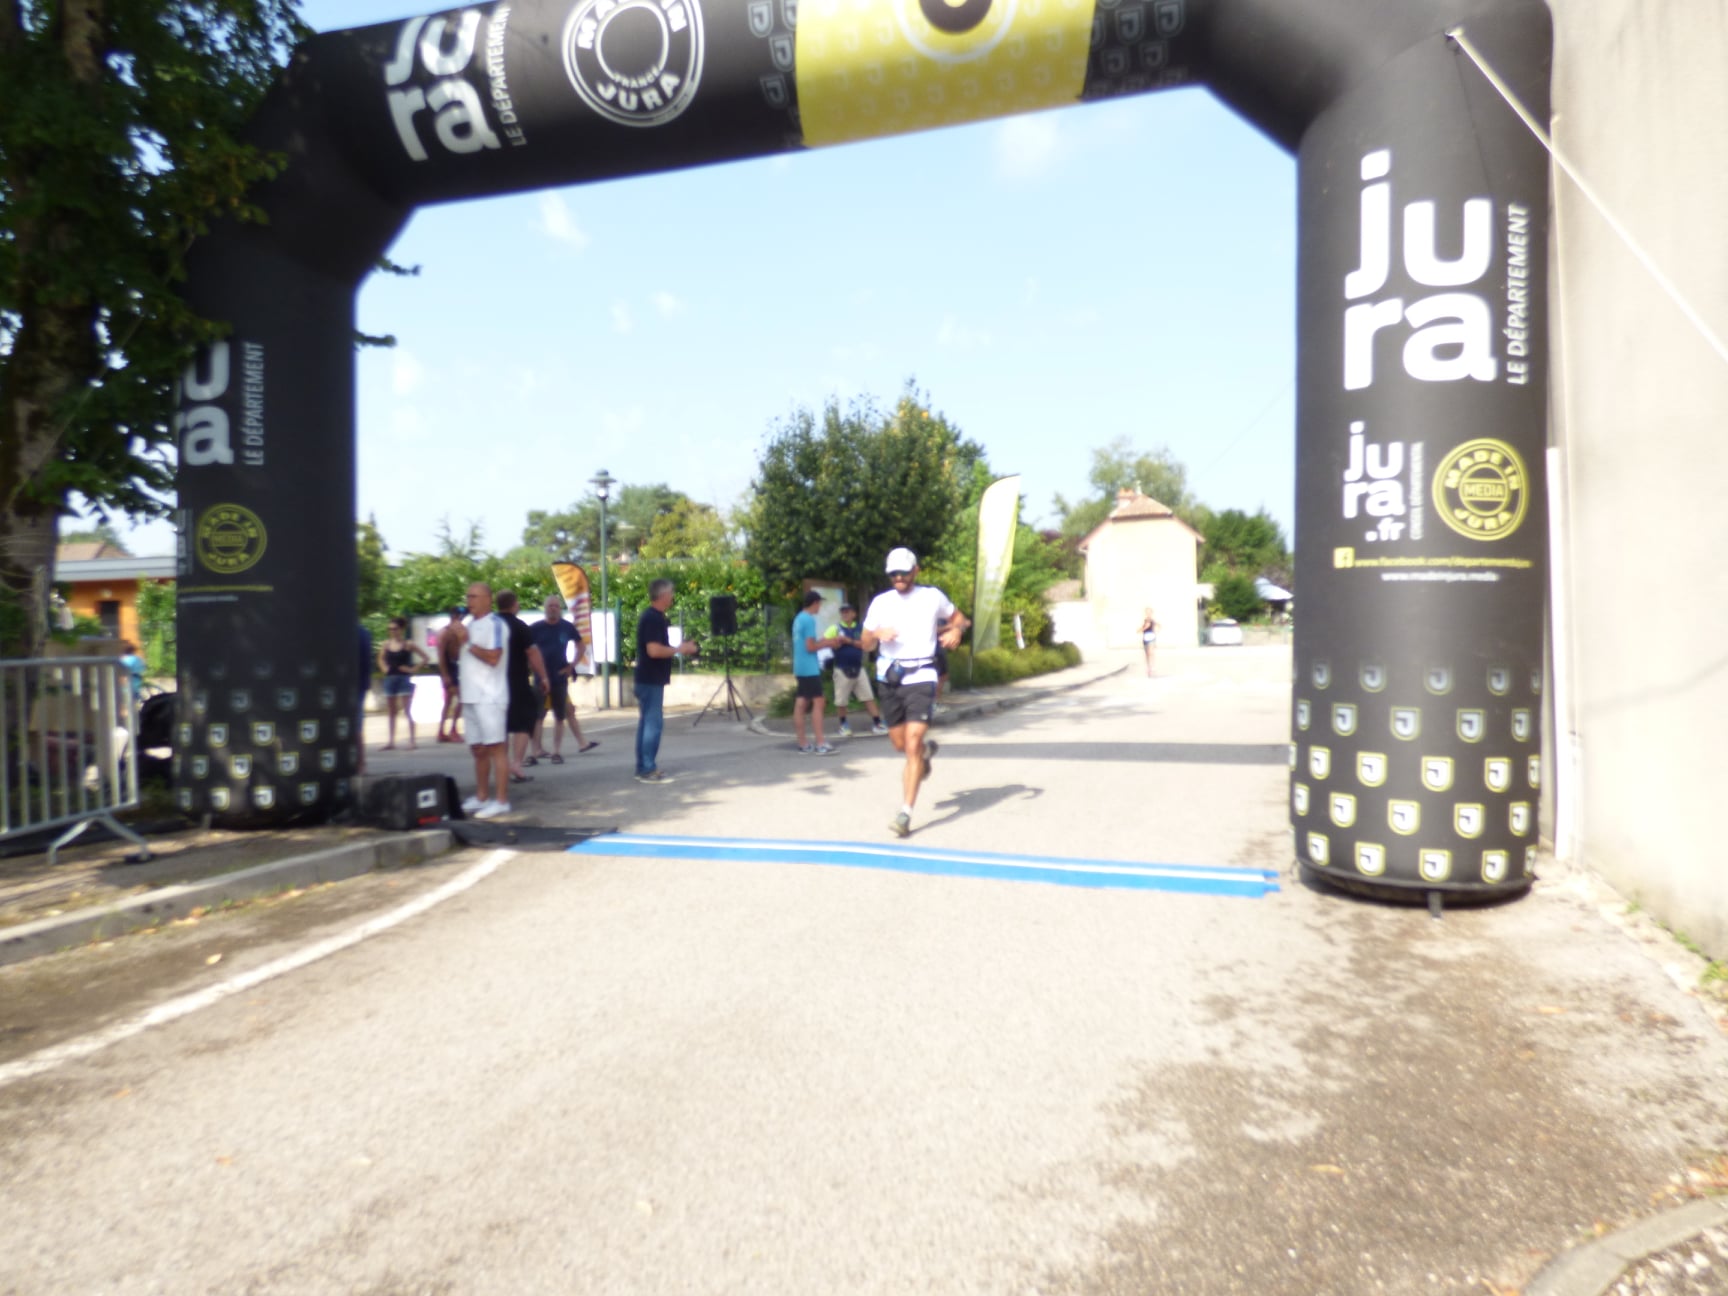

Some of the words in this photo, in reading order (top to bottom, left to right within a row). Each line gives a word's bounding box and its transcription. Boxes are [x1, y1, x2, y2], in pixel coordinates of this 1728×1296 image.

[596, 72, 680, 111] JURA
[387, 77, 501, 162] ra
[503, 122, 528, 147] LE
[1344, 149, 1493, 300] ju
[1503, 203, 1529, 357] DÉPARTEMENT
[1344, 292, 1498, 391] ra
[1506, 361, 1529, 386] LE
[240, 341, 264, 447] DÉPARTEMENT
[244, 451, 264, 465] LE
[1343, 420, 1405, 482] ju
[1343, 479, 1406, 519] ra
[1464, 483, 1504, 497] MEDIA
[1365, 517, 1406, 542] .fr
[1453, 508, 1513, 530] JURA
